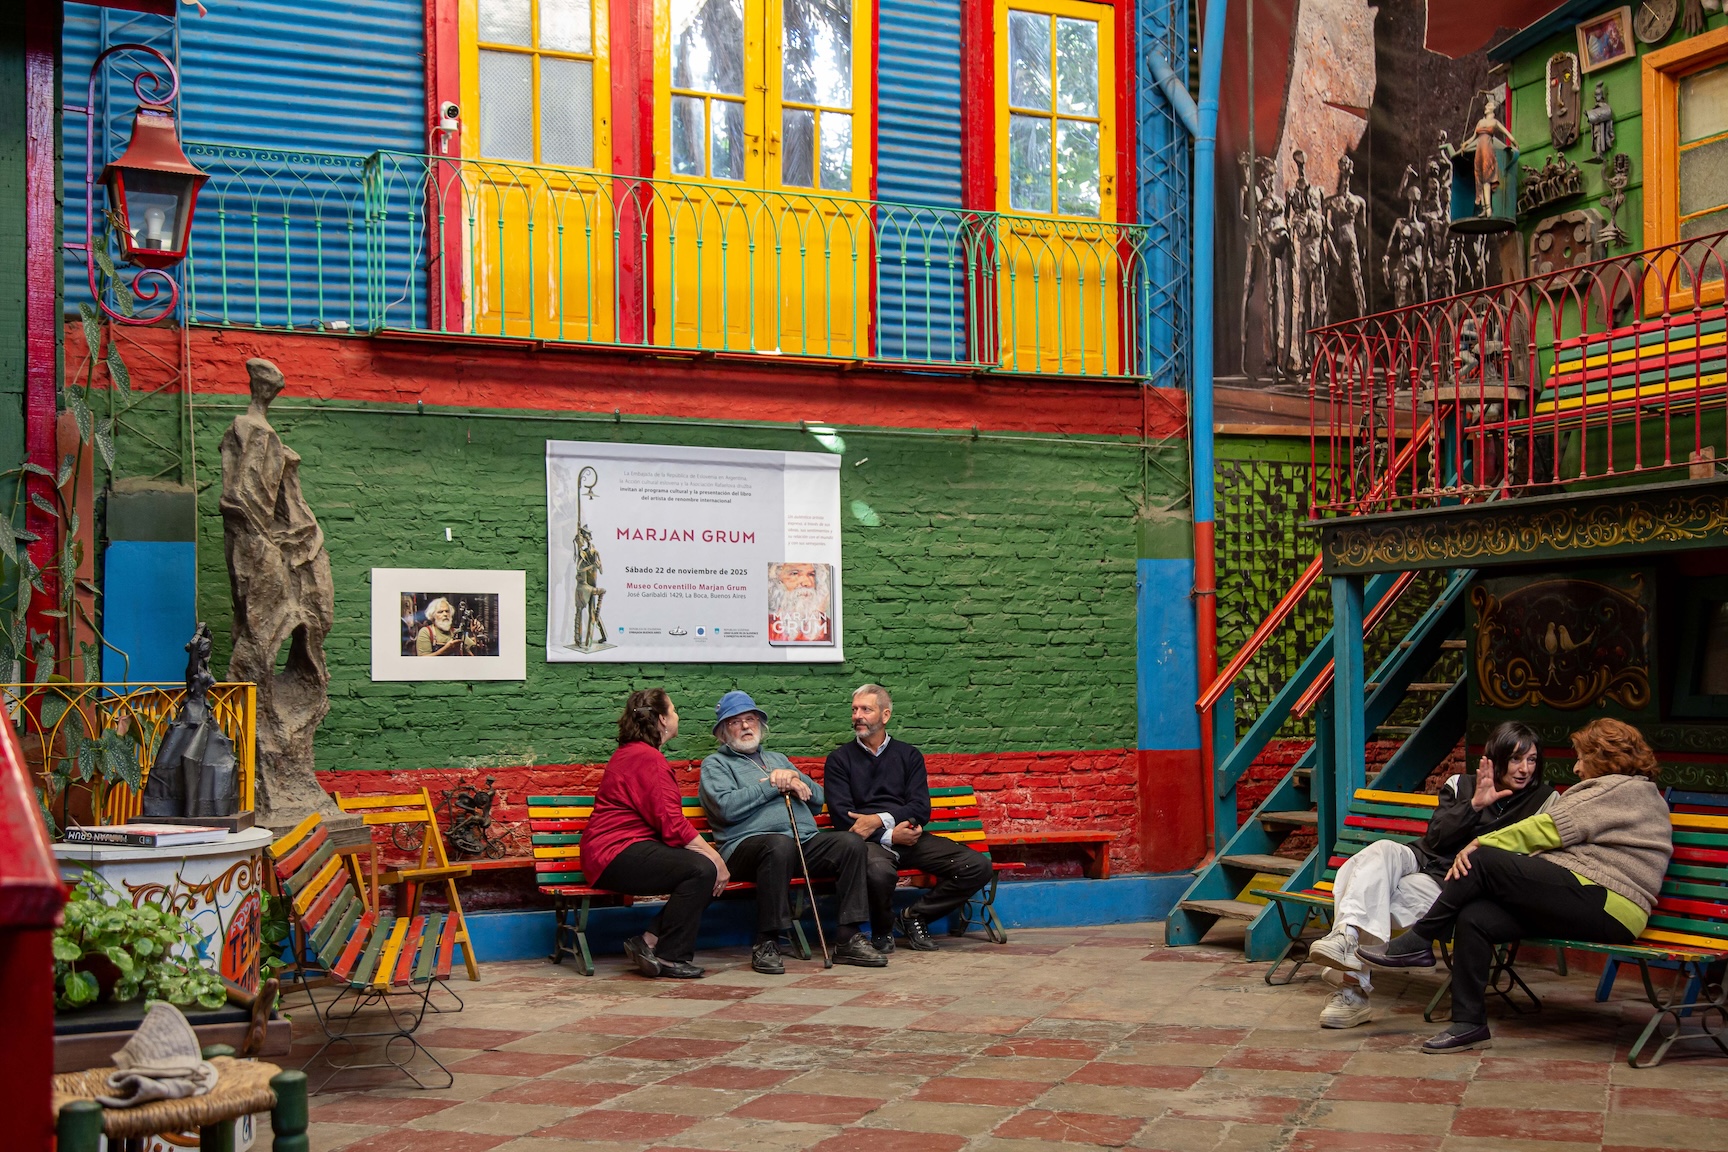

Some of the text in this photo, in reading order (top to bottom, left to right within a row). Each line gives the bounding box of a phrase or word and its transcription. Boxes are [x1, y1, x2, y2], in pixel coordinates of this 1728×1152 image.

[616, 527, 755, 544] MARJAN GRUM
[773, 612, 827, 620] MARJAN
[772, 620, 828, 634] GRUM
